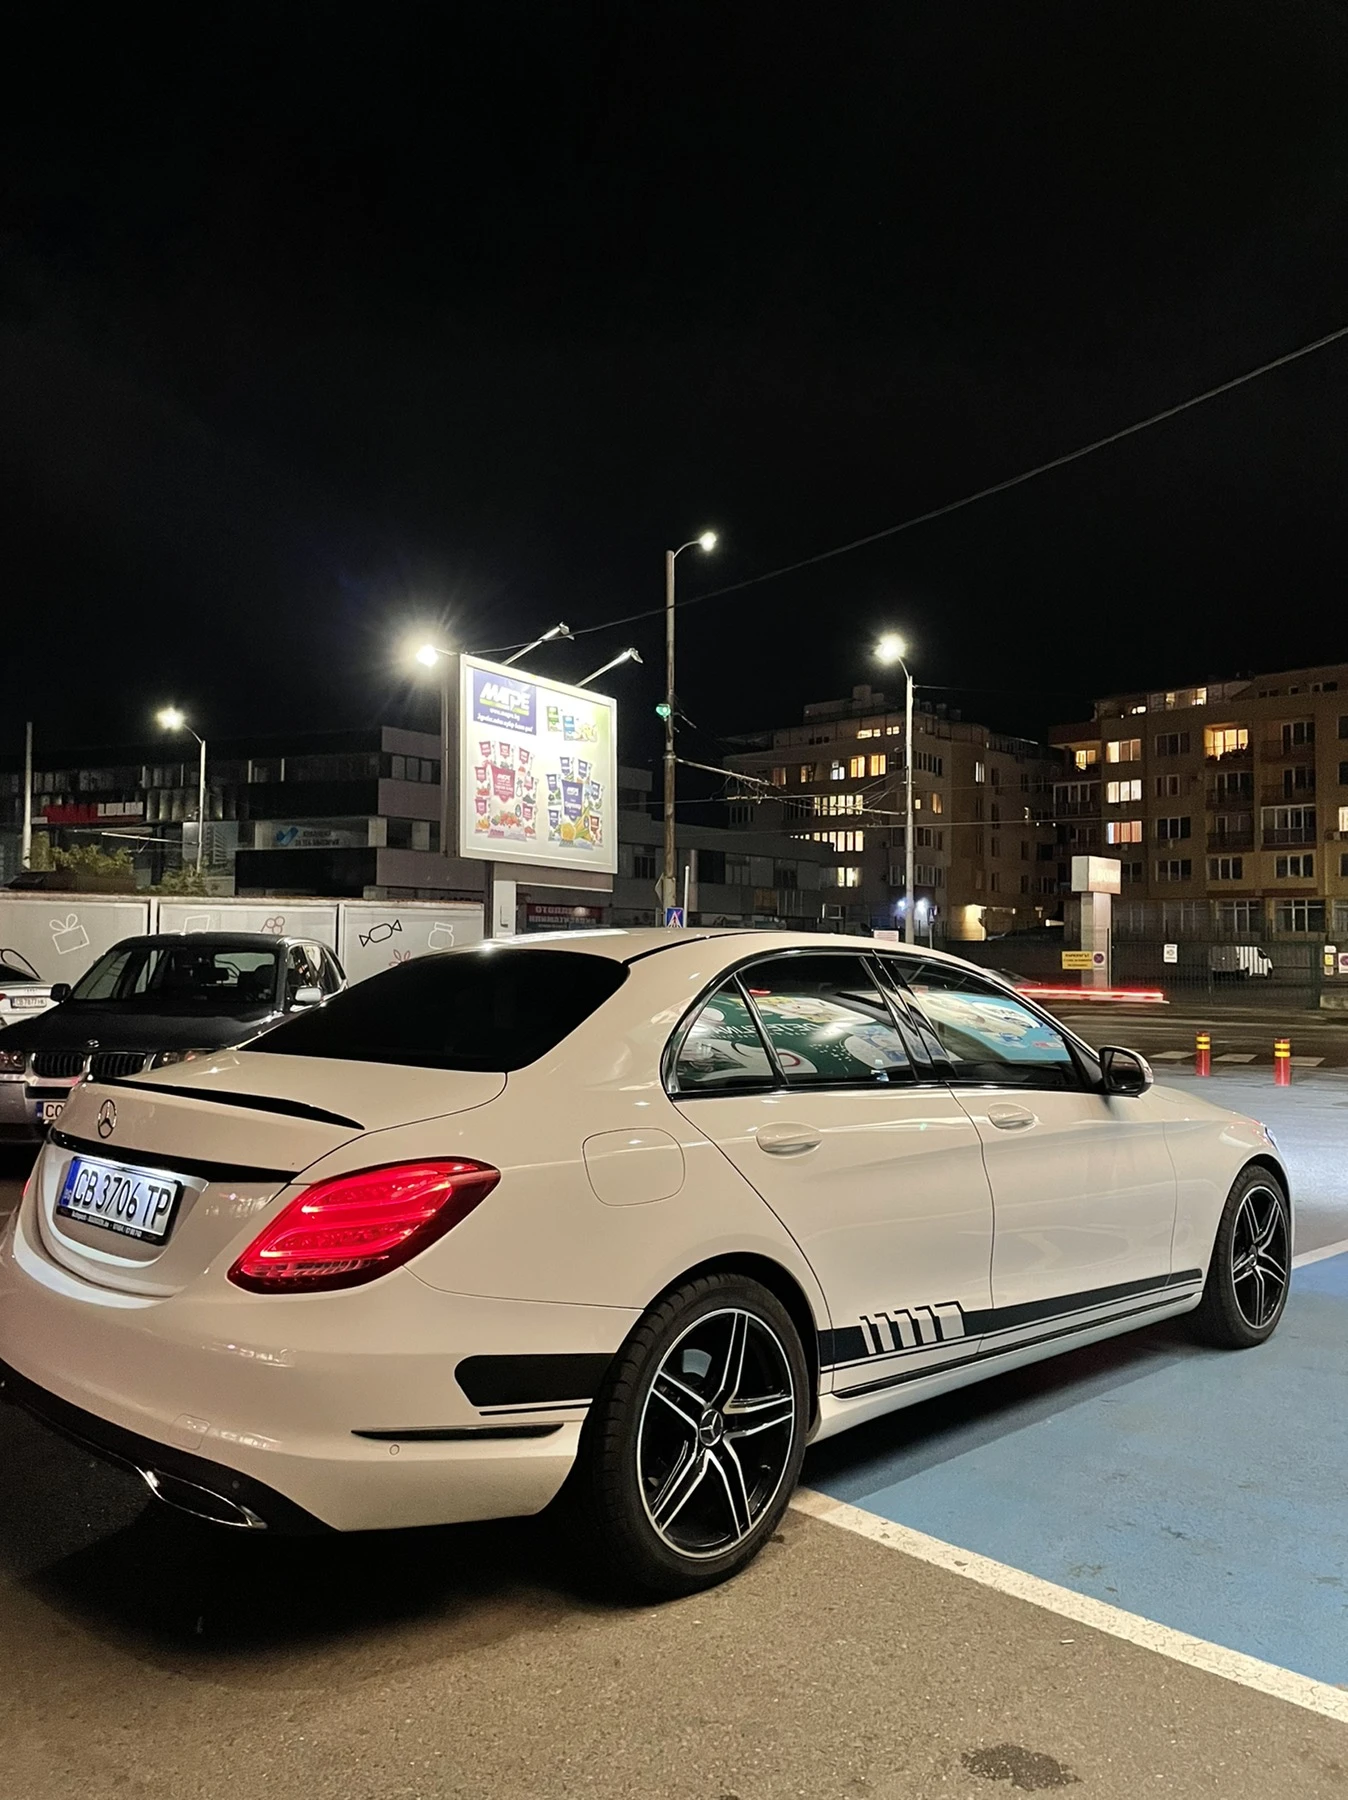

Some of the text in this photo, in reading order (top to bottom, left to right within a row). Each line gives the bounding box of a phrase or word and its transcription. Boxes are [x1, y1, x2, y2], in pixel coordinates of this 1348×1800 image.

[73, 1168, 98, 1206] CB
[96, 1174, 141, 1219] 3706
[142, 1185, 171, 1228] TP
